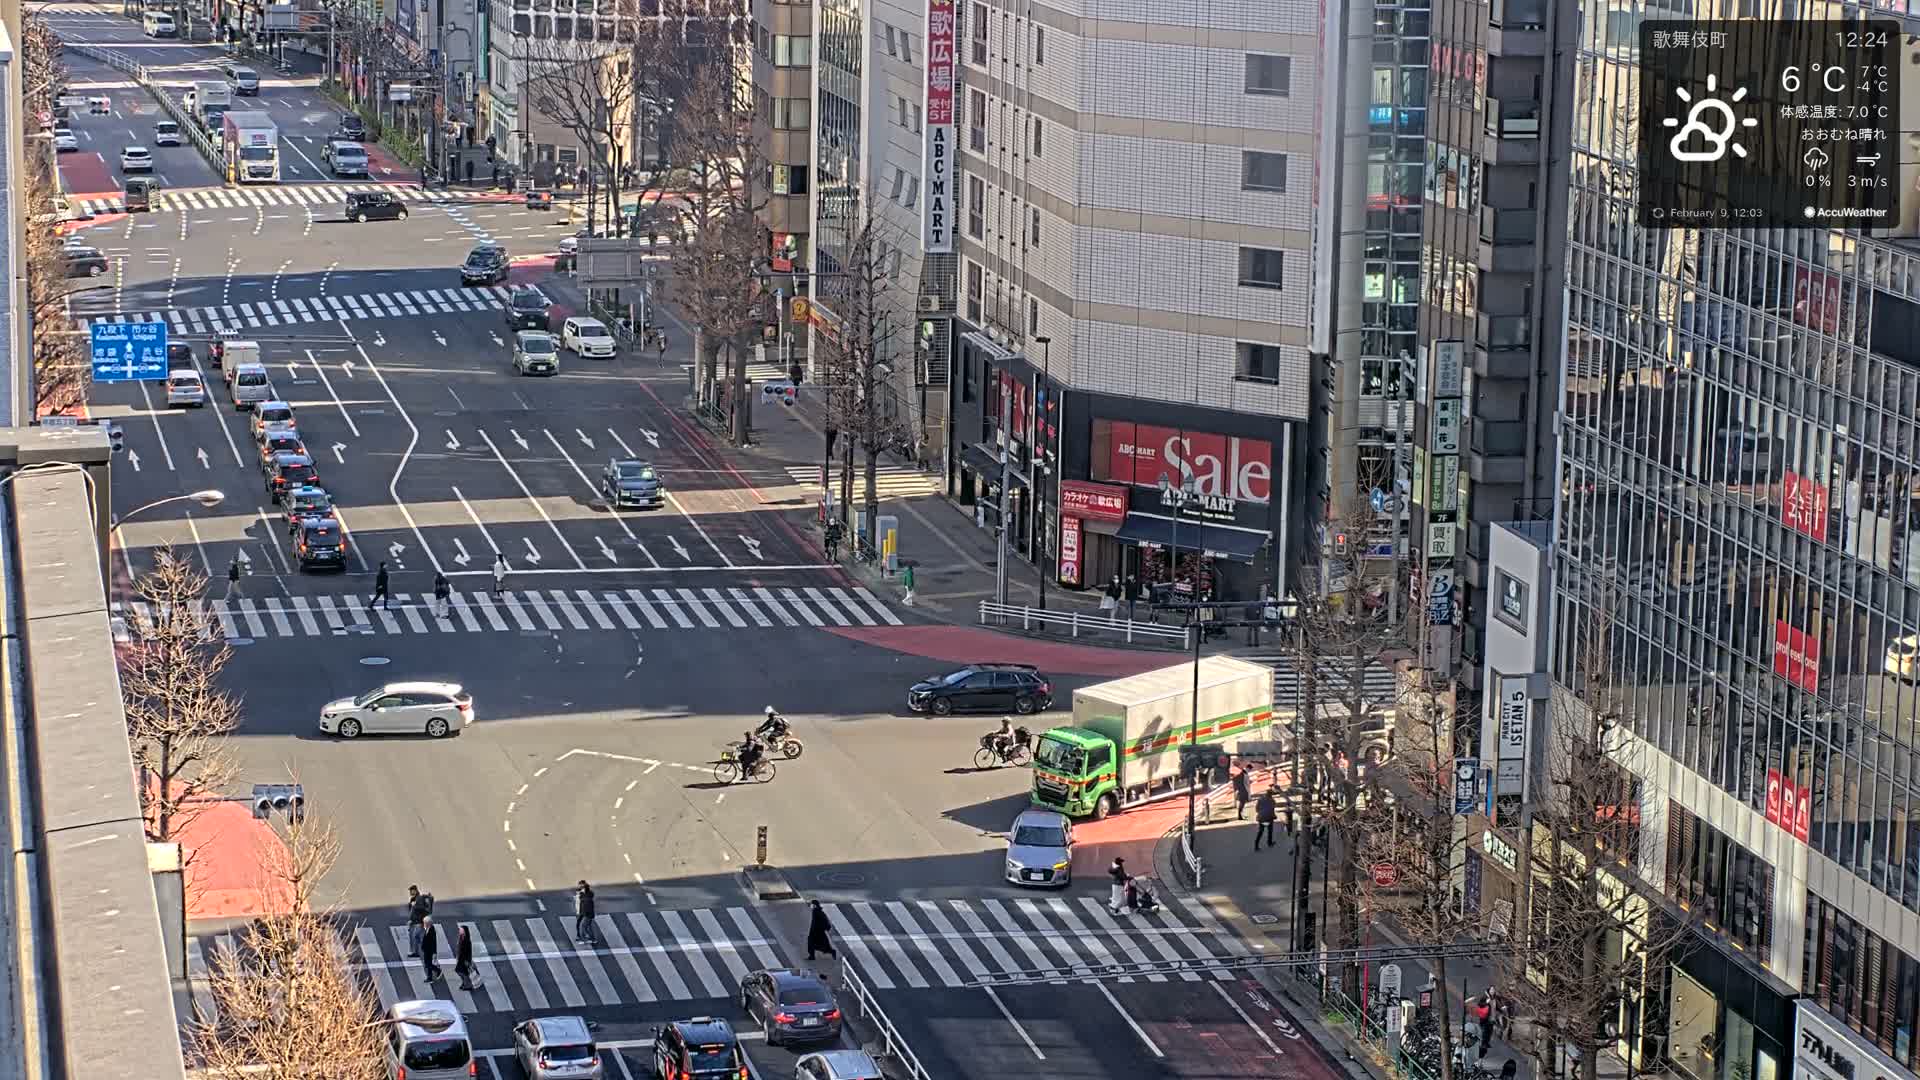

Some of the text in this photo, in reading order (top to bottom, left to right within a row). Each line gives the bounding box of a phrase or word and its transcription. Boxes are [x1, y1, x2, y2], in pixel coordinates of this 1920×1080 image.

[930, 10, 953, 92] 歌広場
[1163, 435, 1271, 504] Sale
[1063, 491, 1089, 503] カラオケ
[1432, 526, 1446, 554] 買取
[1501, 701, 1511, 741] PARK CITY
[1510, 691, 1525, 747] ISETAN 5
[1769, 779, 1808, 830] CPA
